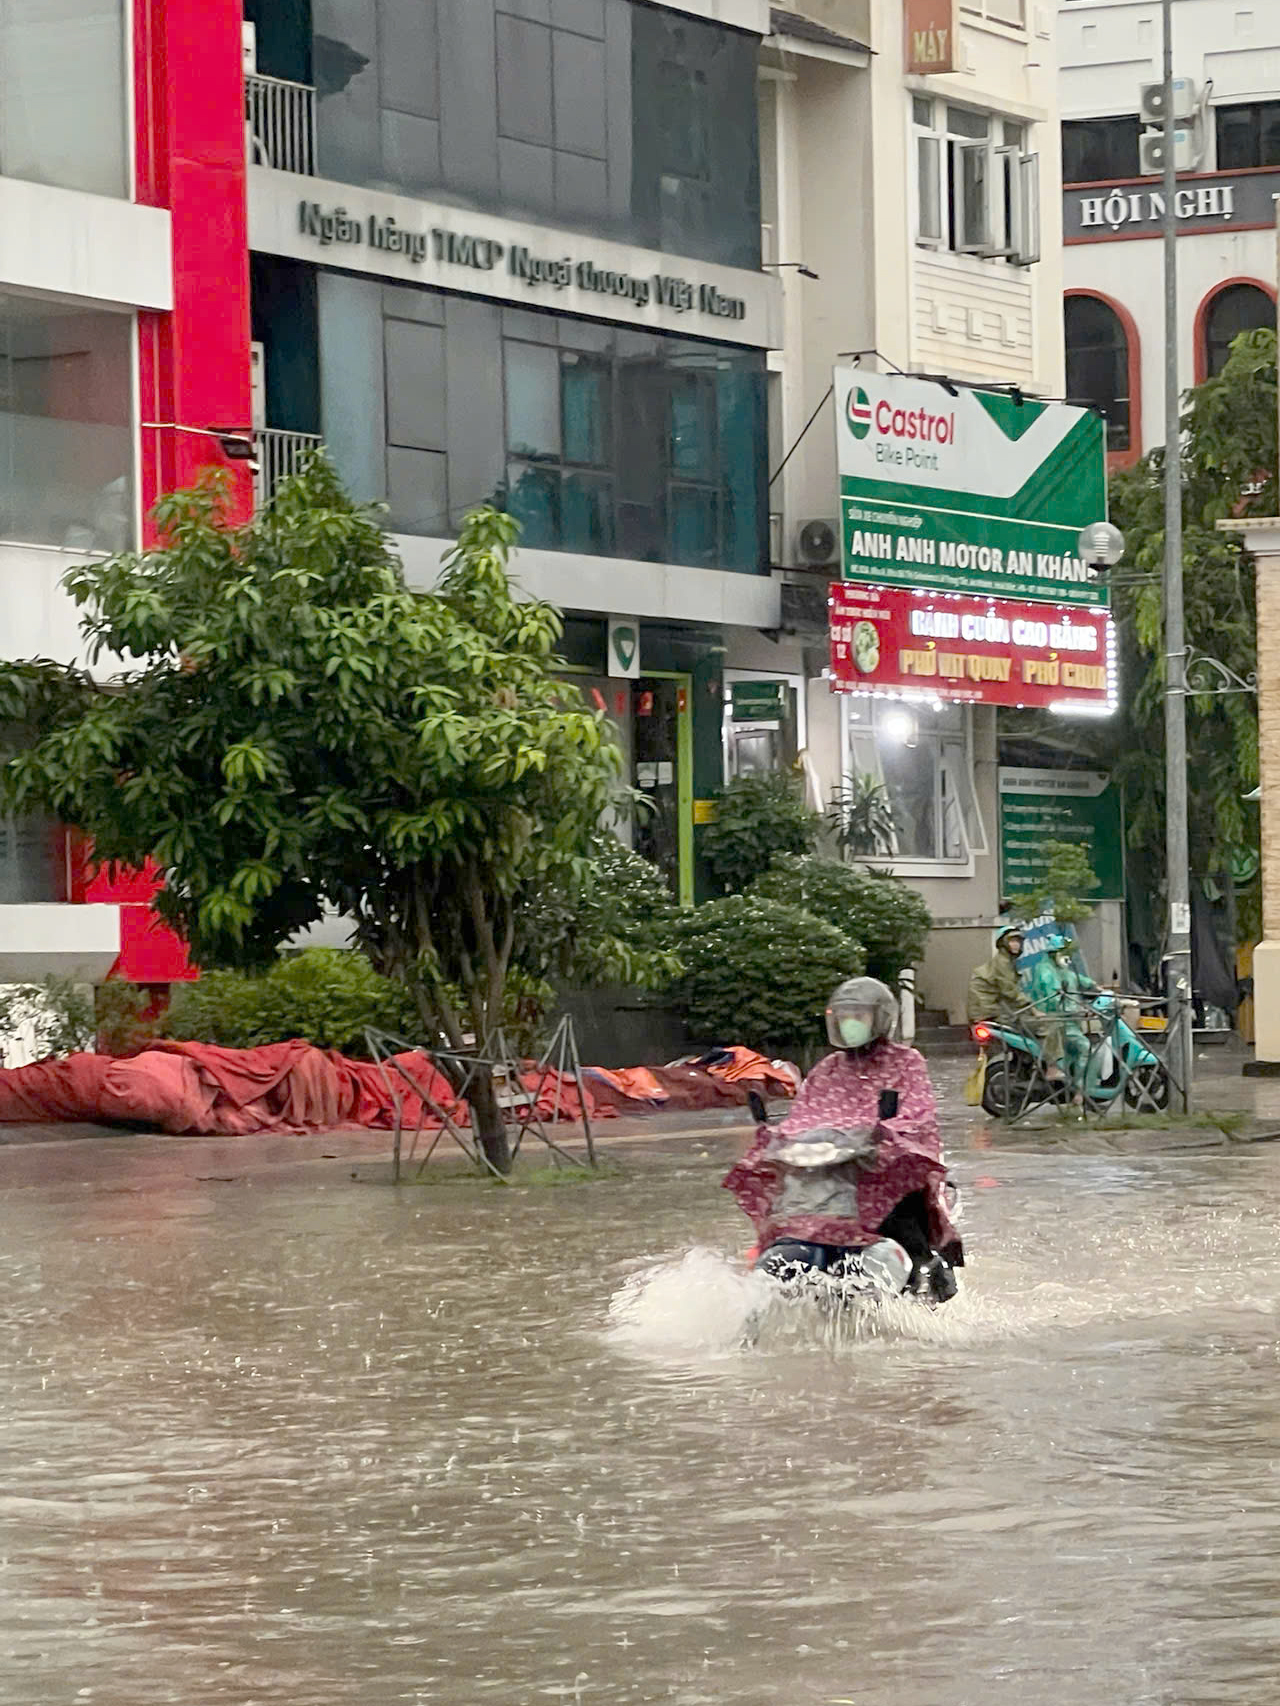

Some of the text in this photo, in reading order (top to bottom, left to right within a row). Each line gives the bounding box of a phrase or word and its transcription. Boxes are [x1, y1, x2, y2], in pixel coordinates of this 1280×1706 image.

[913, 20, 948, 63] MÁY
[1080, 186, 1234, 231] HỘI NGHỊ
[299, 200, 362, 246] Ngân
[367, 215, 426, 264] hàng
[431, 228, 504, 271] TMCP
[508, 245, 573, 291] Ngoại
[651, 275, 694, 314] Việt
[699, 284, 745, 321] Nam
[875, 400, 955, 445] Castrol
[876, 443, 939, 471] Bike Point
[851, 530, 892, 560] ANH
[895, 536, 936, 565] ANH
[939, 541, 1004, 574] MOTOR
[1006, 550, 1033, 576] AN
[911, 605, 960, 638] BÁNH
[1012, 619, 1048, 648] CAO
[967, 653, 1012, 682] QUAY
